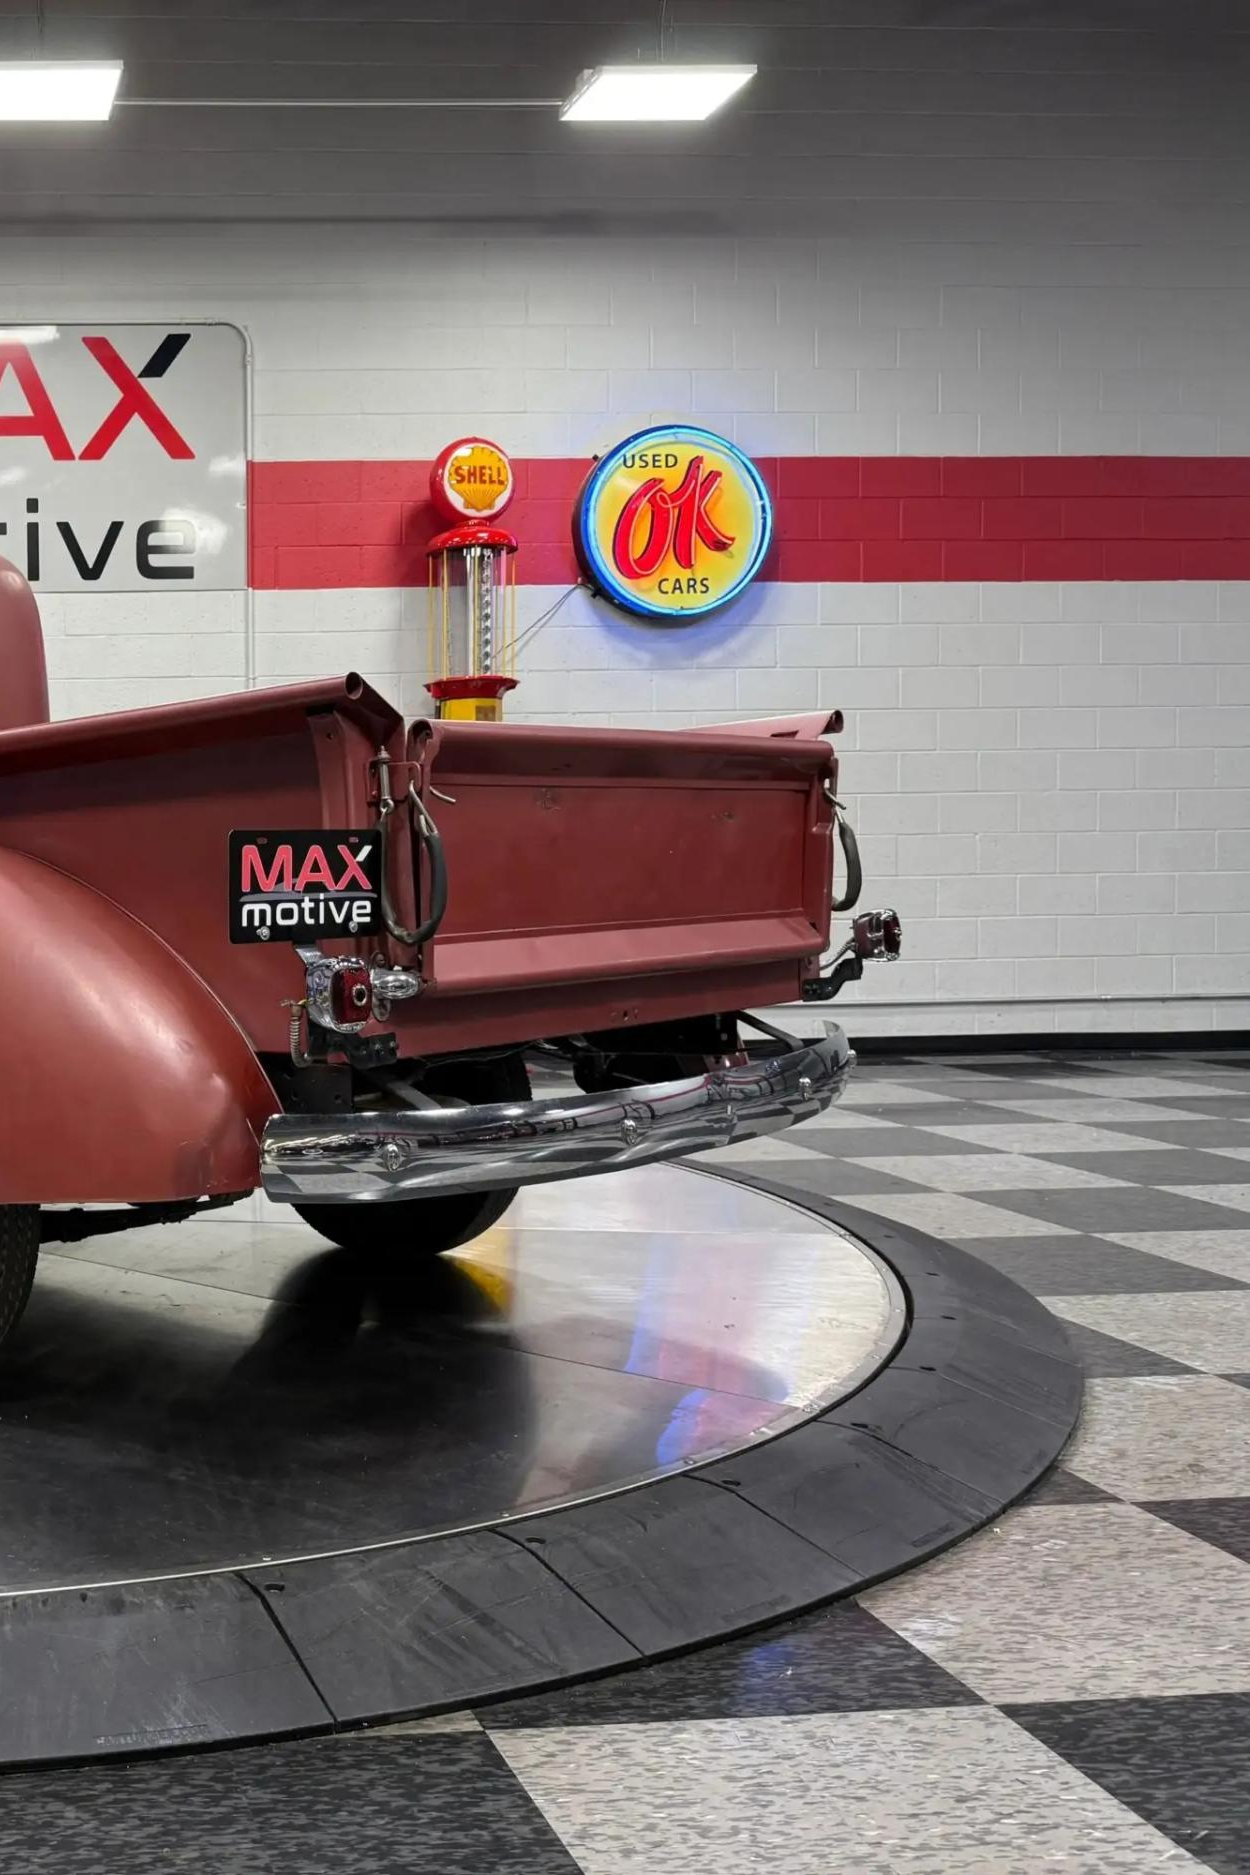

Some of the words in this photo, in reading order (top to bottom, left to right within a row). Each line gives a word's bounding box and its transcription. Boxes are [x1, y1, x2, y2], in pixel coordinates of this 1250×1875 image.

[622, 453, 679, 470] USED
[454, 465, 505, 486] SHELL
[613, 456, 736, 580] OK
[657, 577, 710, 595] CARS
[241, 844, 373, 892] MAX
[241, 893, 372, 927] motive
